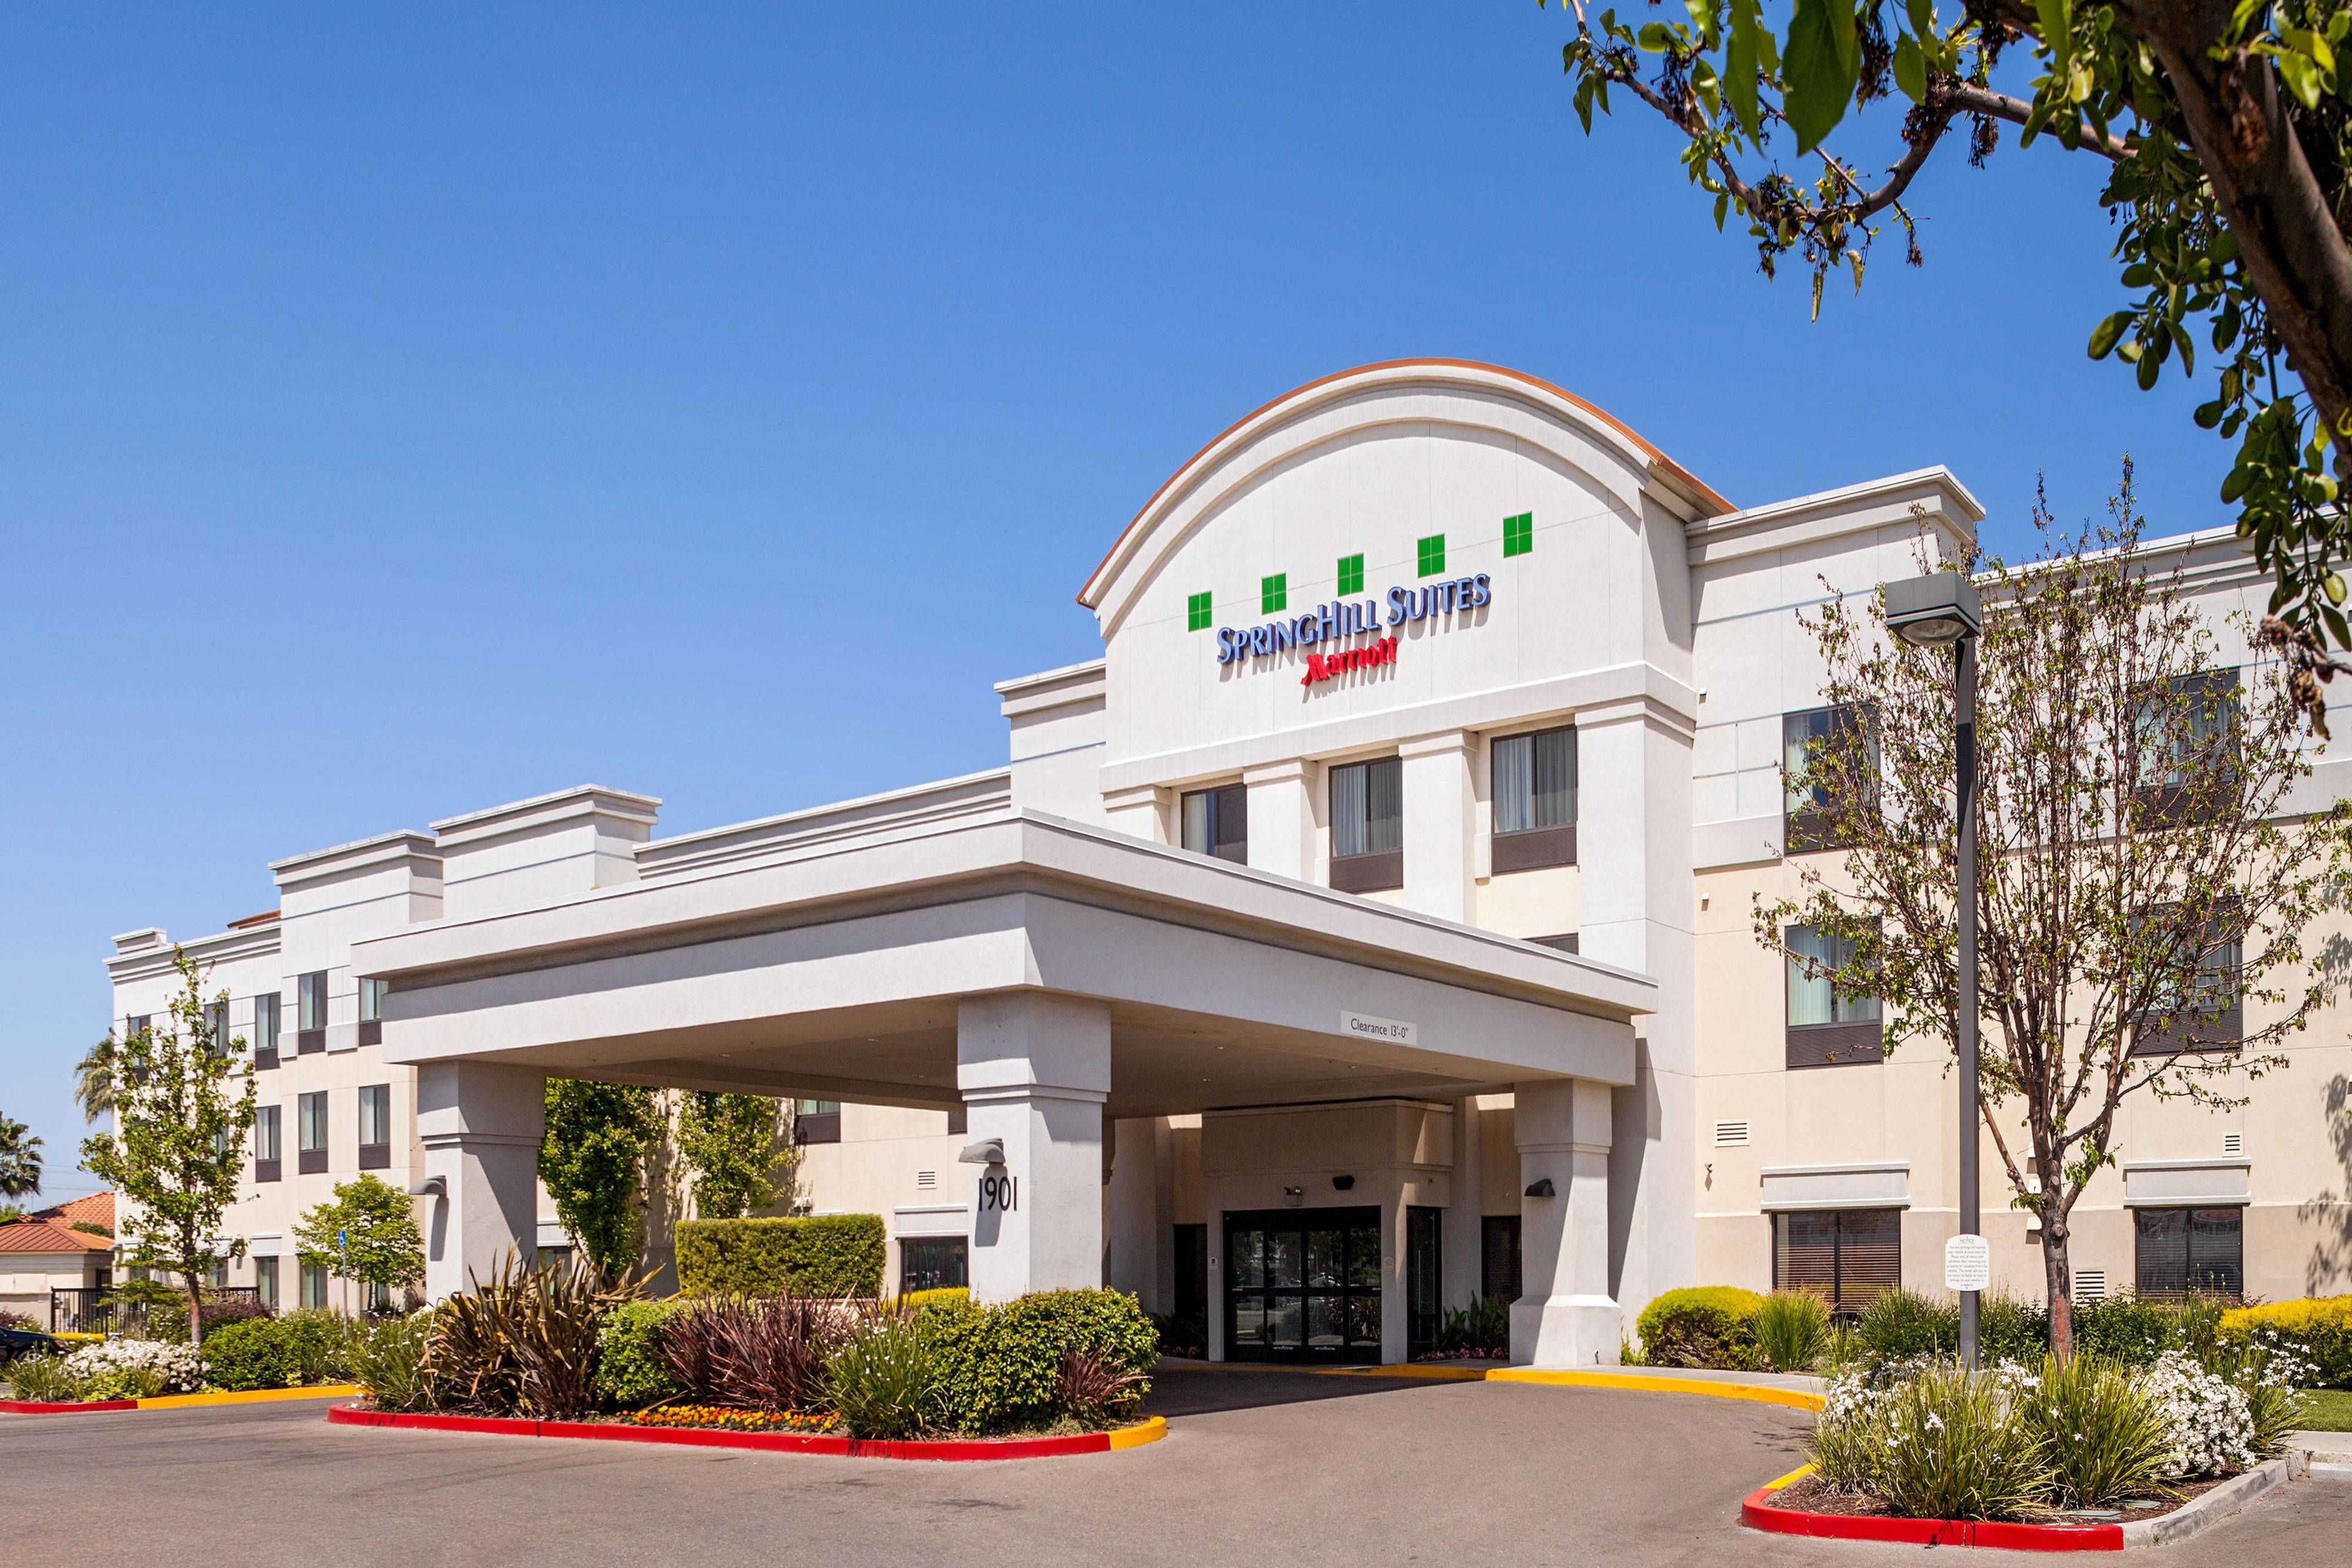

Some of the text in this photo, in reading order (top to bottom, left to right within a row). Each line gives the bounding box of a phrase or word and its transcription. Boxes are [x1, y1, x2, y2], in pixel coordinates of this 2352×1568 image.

[1387, 573, 1491, 627] SUITES
[1300, 635, 1397, 686] Marriott
[1351, 1018, 1387, 1035] Clearance
[979, 1176, 1017, 1212] 1901
